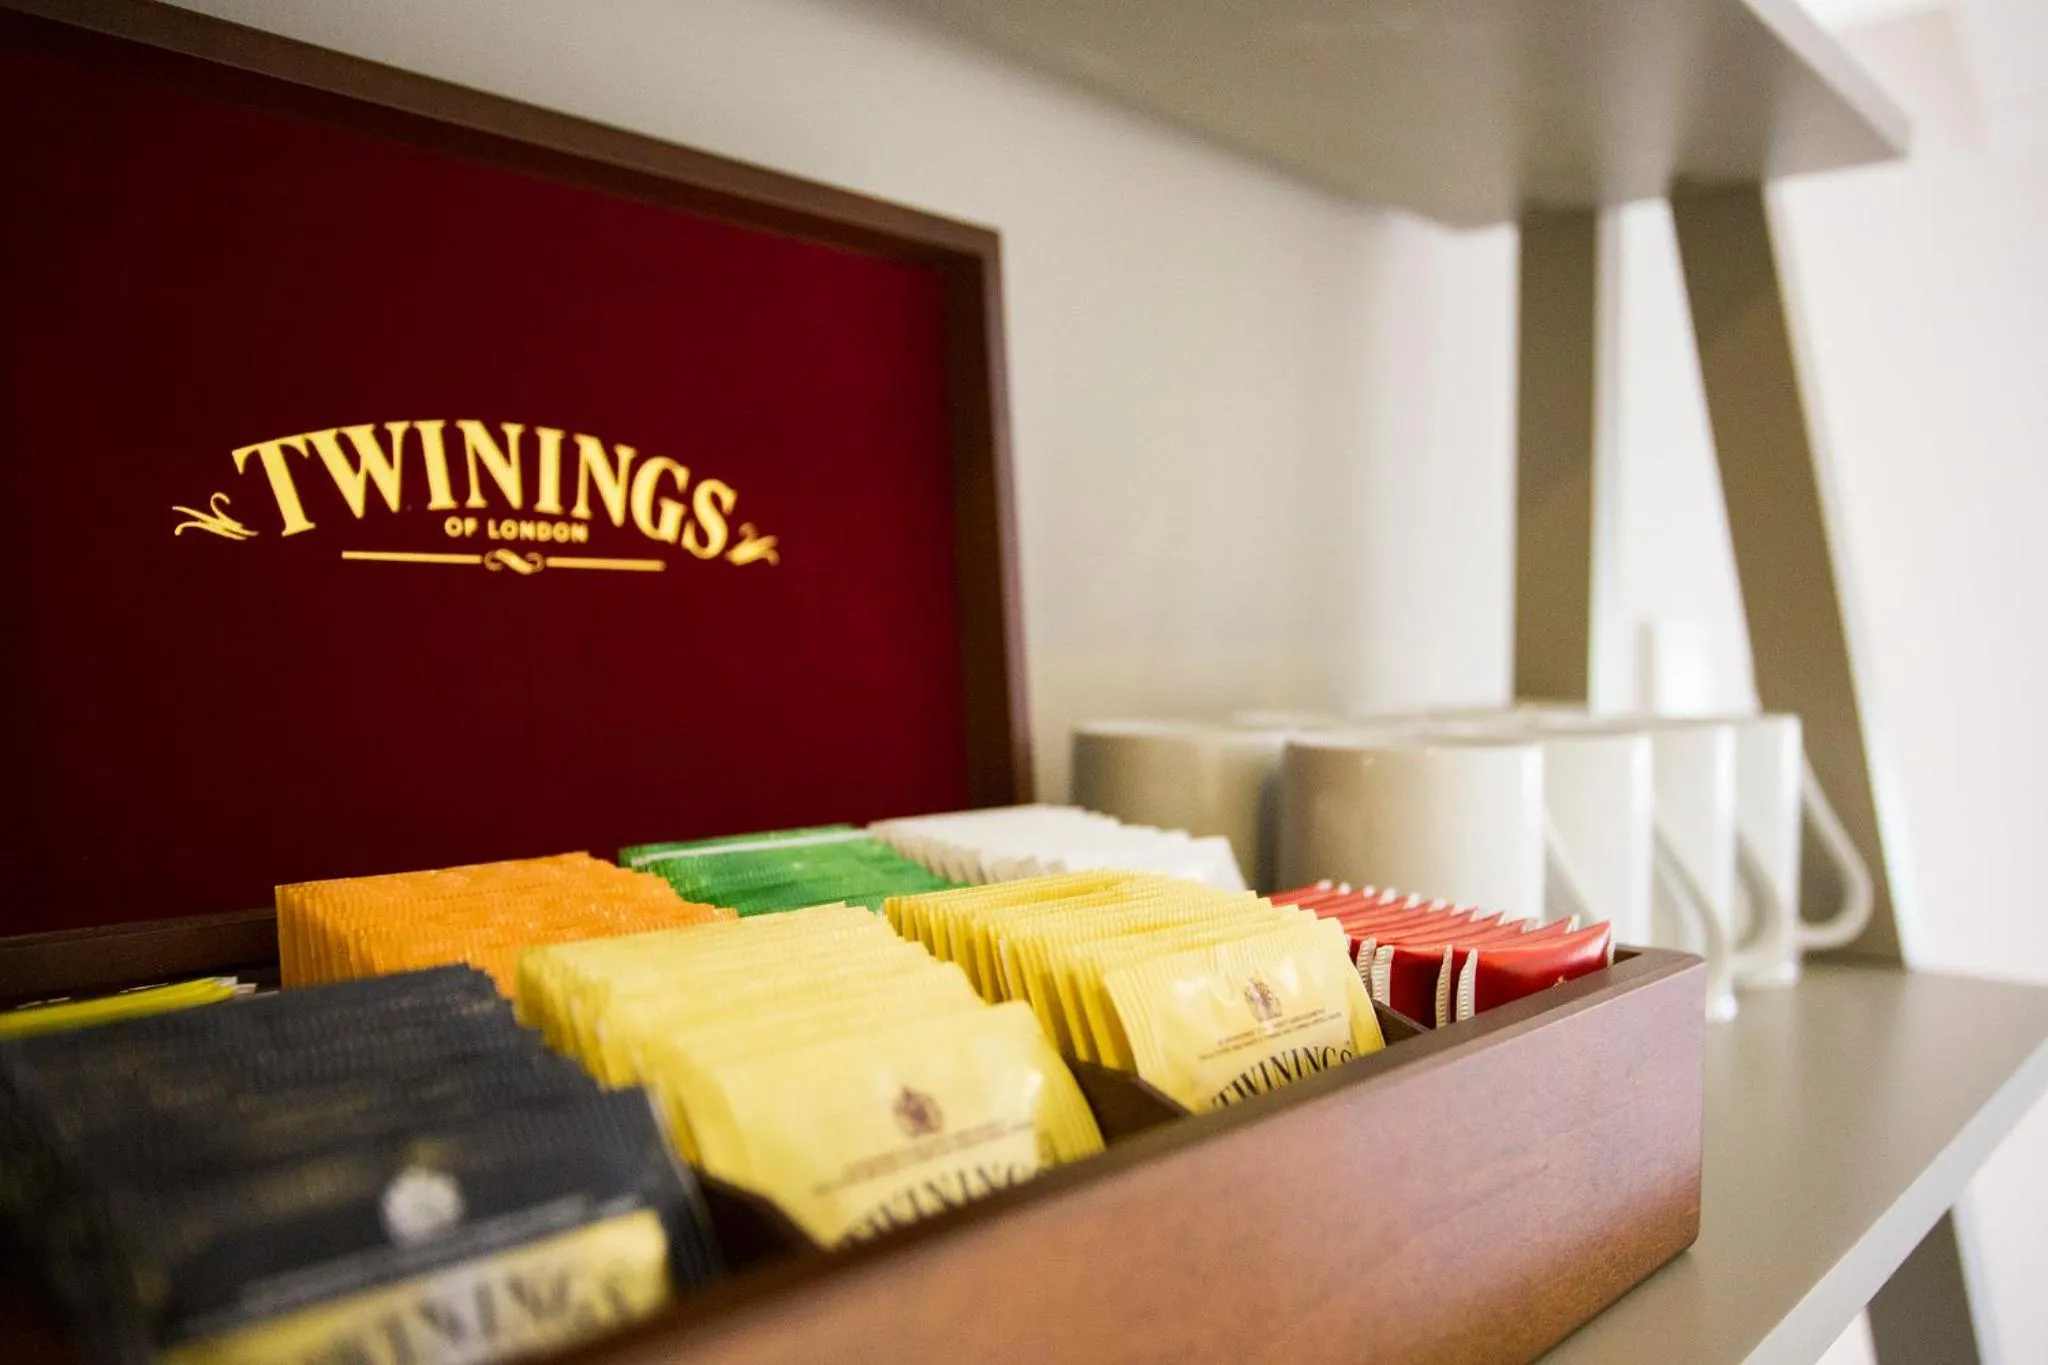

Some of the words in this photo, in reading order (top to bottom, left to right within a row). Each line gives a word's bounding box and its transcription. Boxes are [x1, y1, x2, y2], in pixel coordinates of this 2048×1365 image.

[231, 419, 738, 561] TWININGS
[443, 515, 478, 538] OF
[486, 517, 590, 543] LONDON
